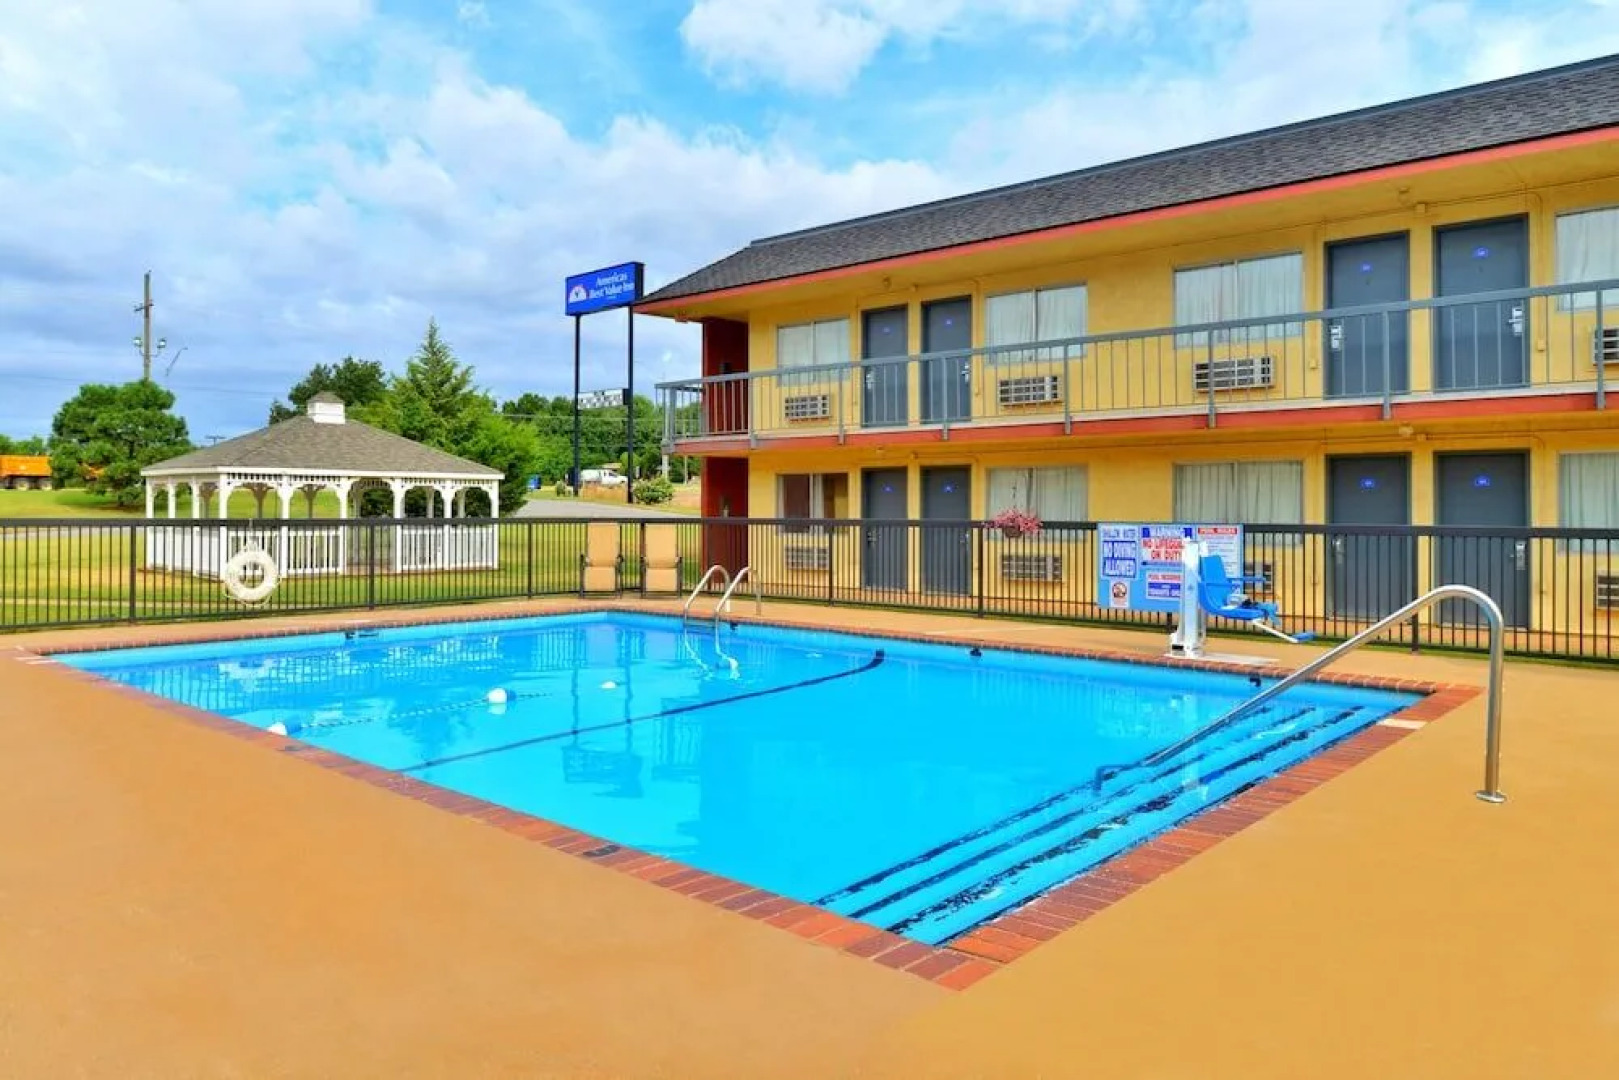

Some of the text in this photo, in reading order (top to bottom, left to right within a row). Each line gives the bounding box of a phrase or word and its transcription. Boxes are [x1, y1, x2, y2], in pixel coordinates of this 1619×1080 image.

[597, 271, 628, 287] Americas
[589, 287, 604, 298] Best
[604, 284, 622, 295] Value
[622, 281, 635, 292] Inn
[1150, 527, 1184, 537] WARNING
[1103, 541, 1135, 558] NO DIVING
[1143, 538, 1152, 548] NO
[1151, 550, 1161, 559] ON
[1105, 559, 1135, 575] ALLOWED
